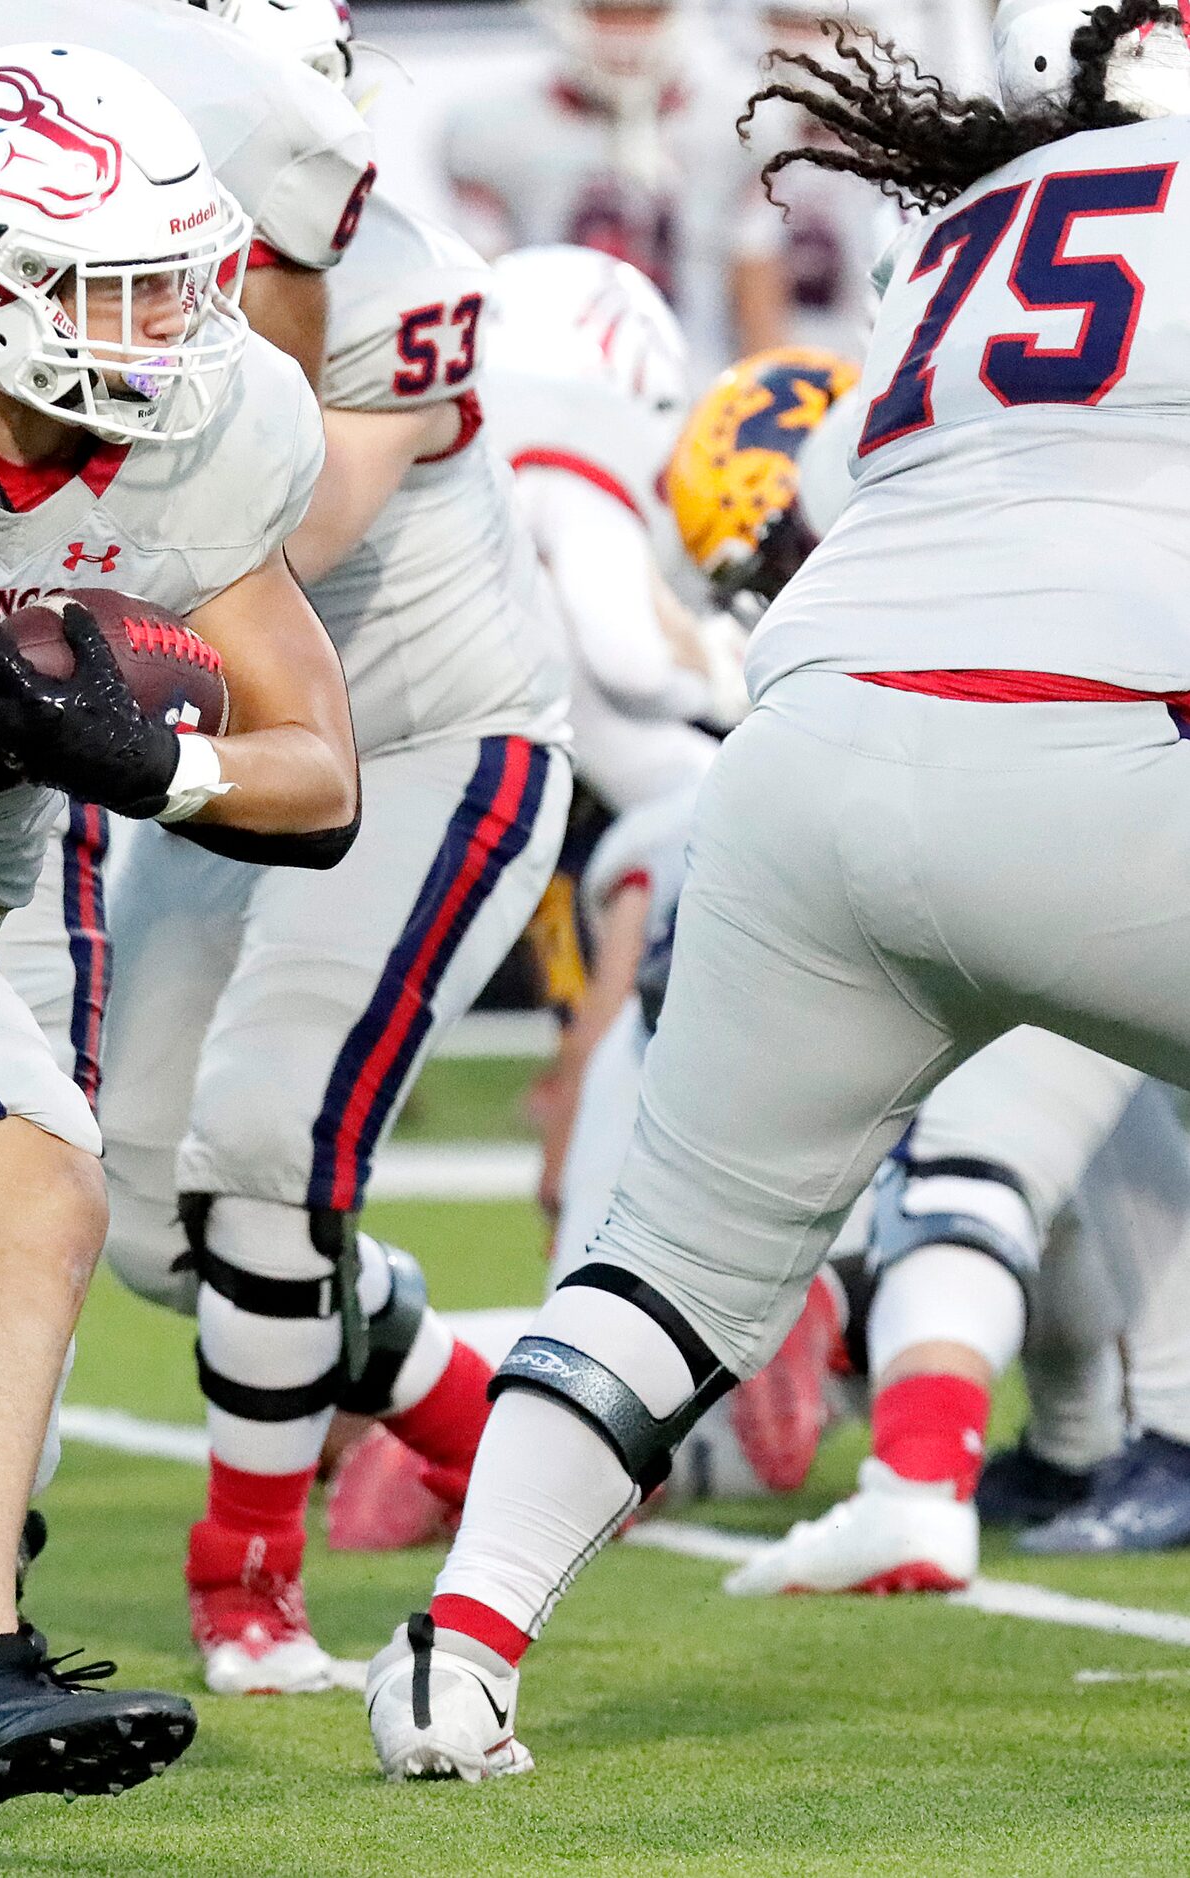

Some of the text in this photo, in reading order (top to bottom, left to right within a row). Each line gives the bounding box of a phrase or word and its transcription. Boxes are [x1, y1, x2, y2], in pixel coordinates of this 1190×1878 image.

[170, 201, 217, 235] Riddell
[393, 292, 482, 396] 53
[857, 161, 1179, 458] 75
